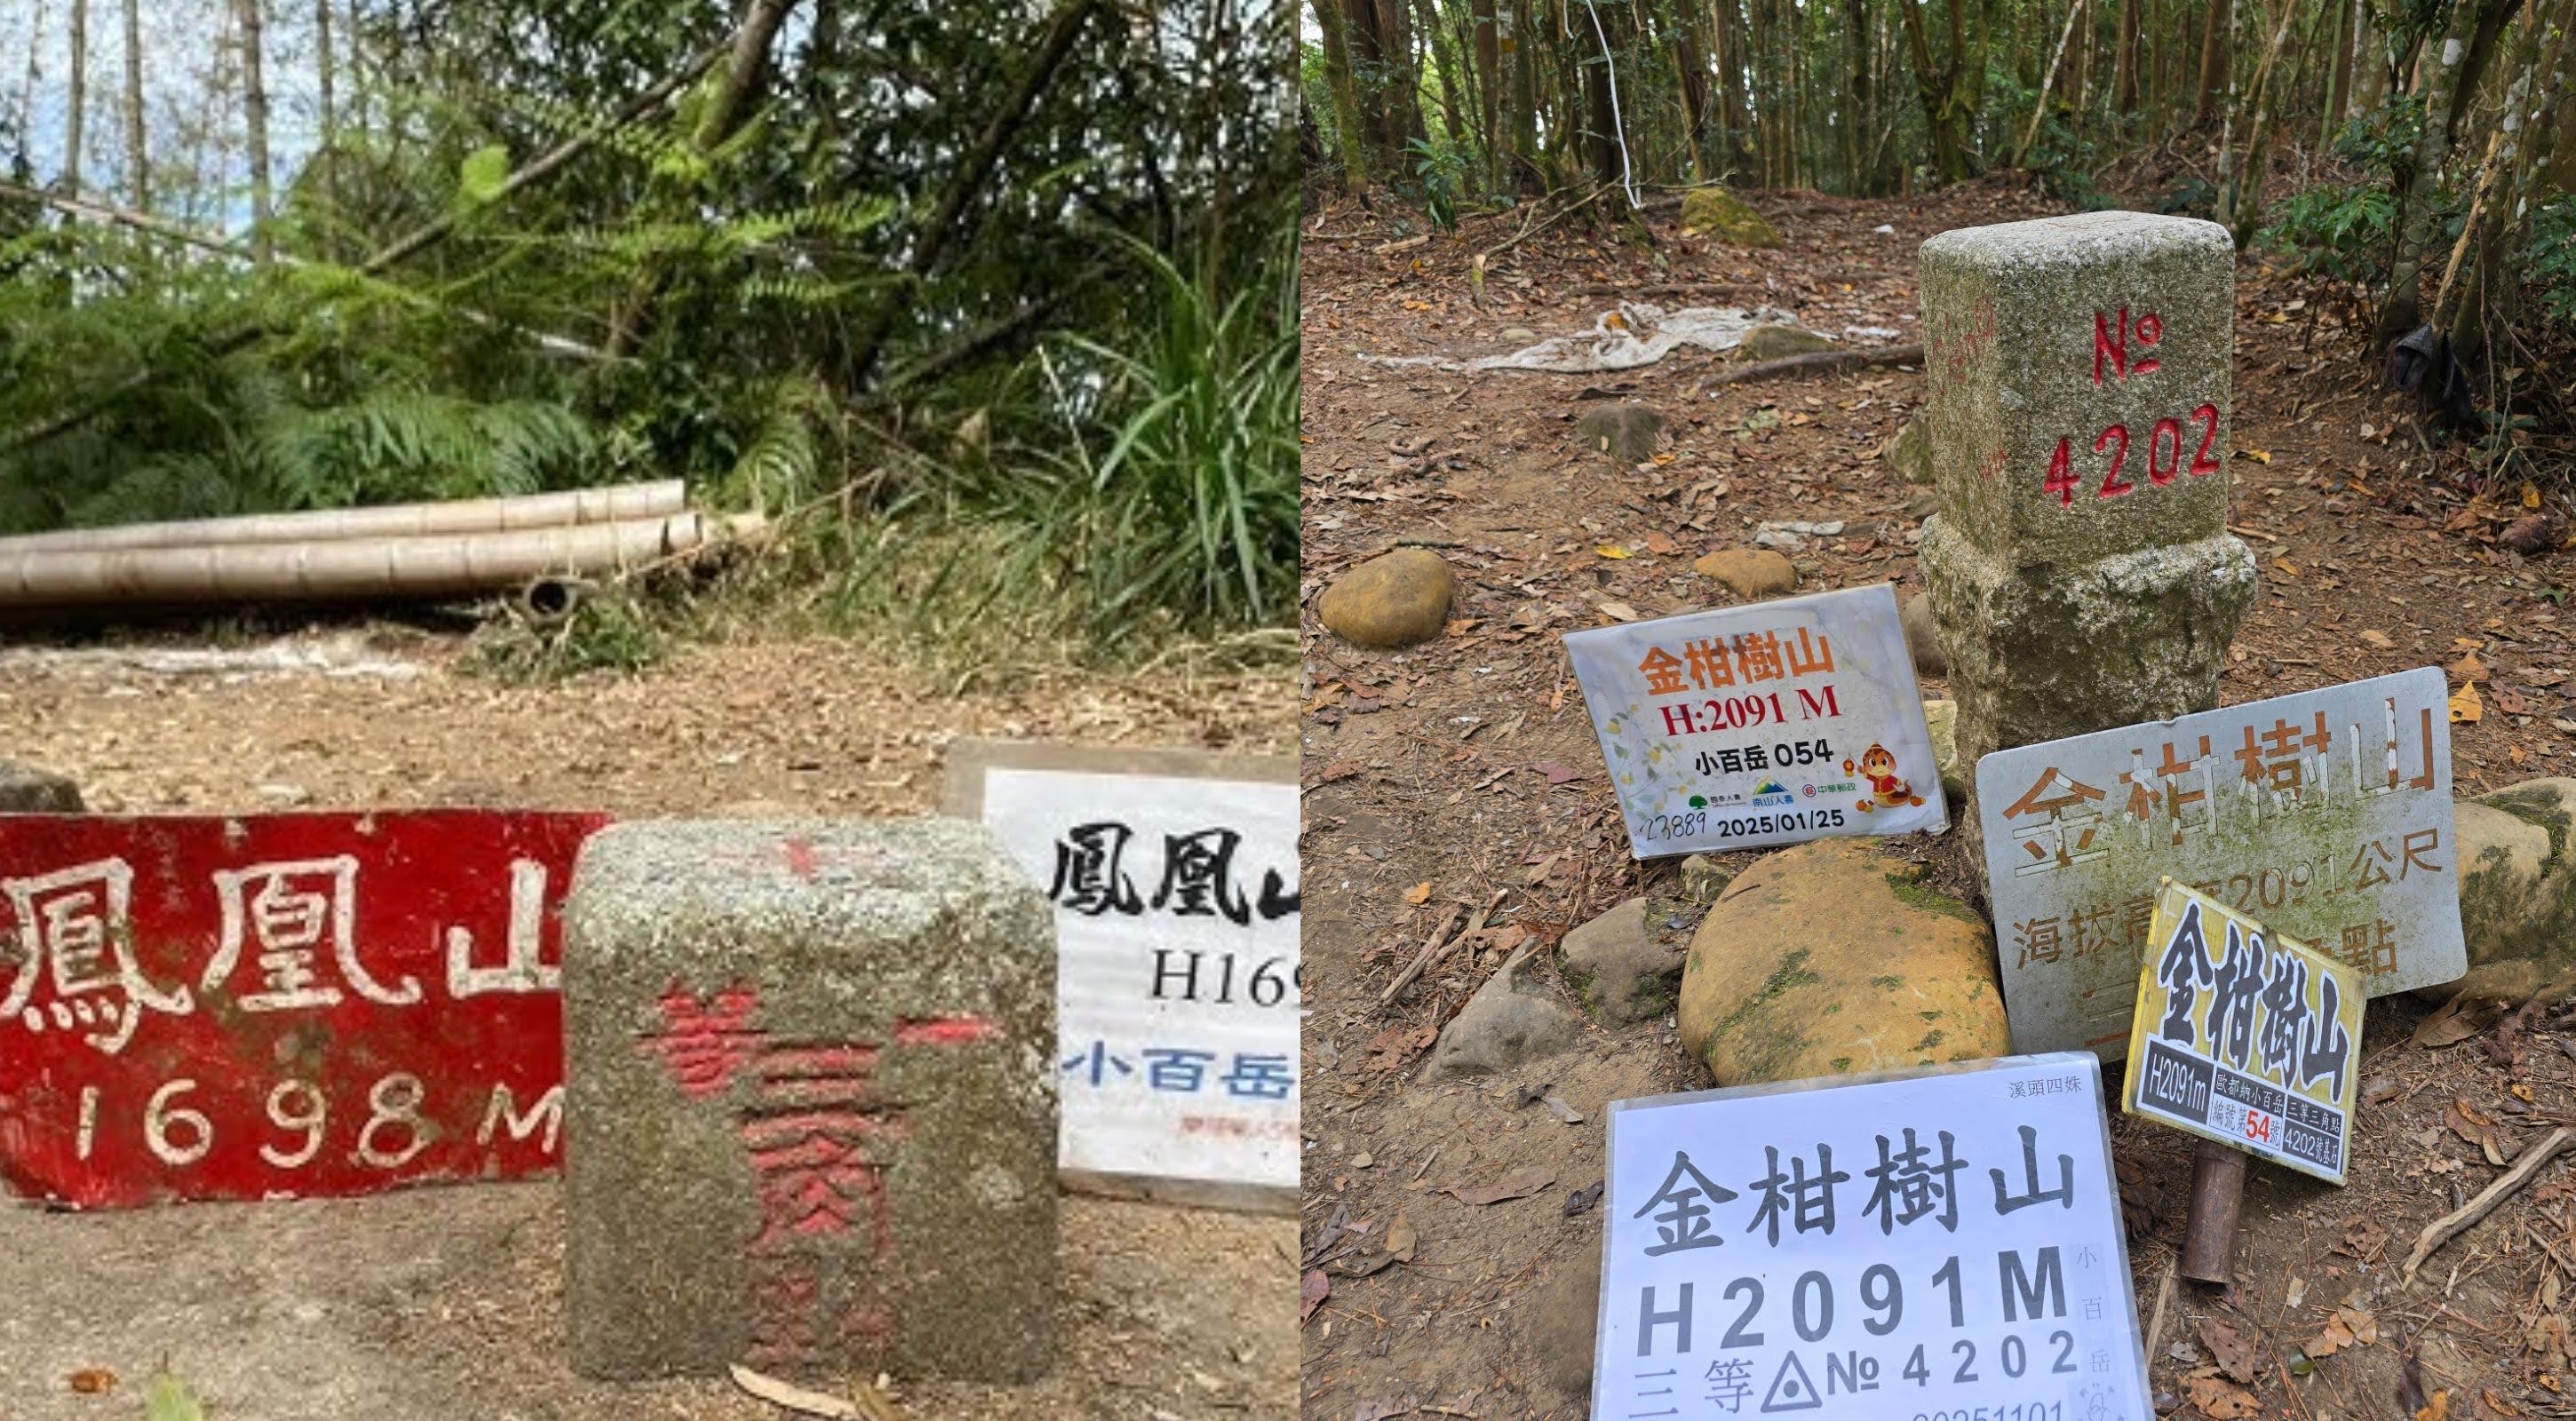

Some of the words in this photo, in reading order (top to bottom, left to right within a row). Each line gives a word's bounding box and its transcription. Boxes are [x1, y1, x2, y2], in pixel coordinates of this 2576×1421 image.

[2043, 402, 2221, 509] 4202
[1638, 626, 1835, 696] 金柑樹山
[1658, 692, 1789, 736] H:2091
[1795, 685, 1842, 721] M
[1695, 744, 1768, 776] 小百岳
[1774, 738, 1833, 766] 054
[1752, 795, 1794, 808] 南山人壽
[2002, 697, 2435, 877] 金柑樹山
[1717, 809, 1845, 838] 2025/01/25
[0, 856, 561, 1053] 鳳凰山
[1153, 949, 1300, 1007] H16
[2159, 901, 2349, 1101] 金柑樹山
[1061, 1041, 1294, 1099] 小百岳
[2150, 1053, 2206, 1112] H2091m
[2287, 1100, 2341, 1133] 三等三角點
[2284, 1127, 2338, 1165] 4202號基石
[1633, 1124, 2075, 1258] 金柑樹山
[2075, 1246, 2111, 1372] 小百岳
[1628, 1358, 1755, 1419] 三等
[1912, 1400, 2063, 1421] 51101
